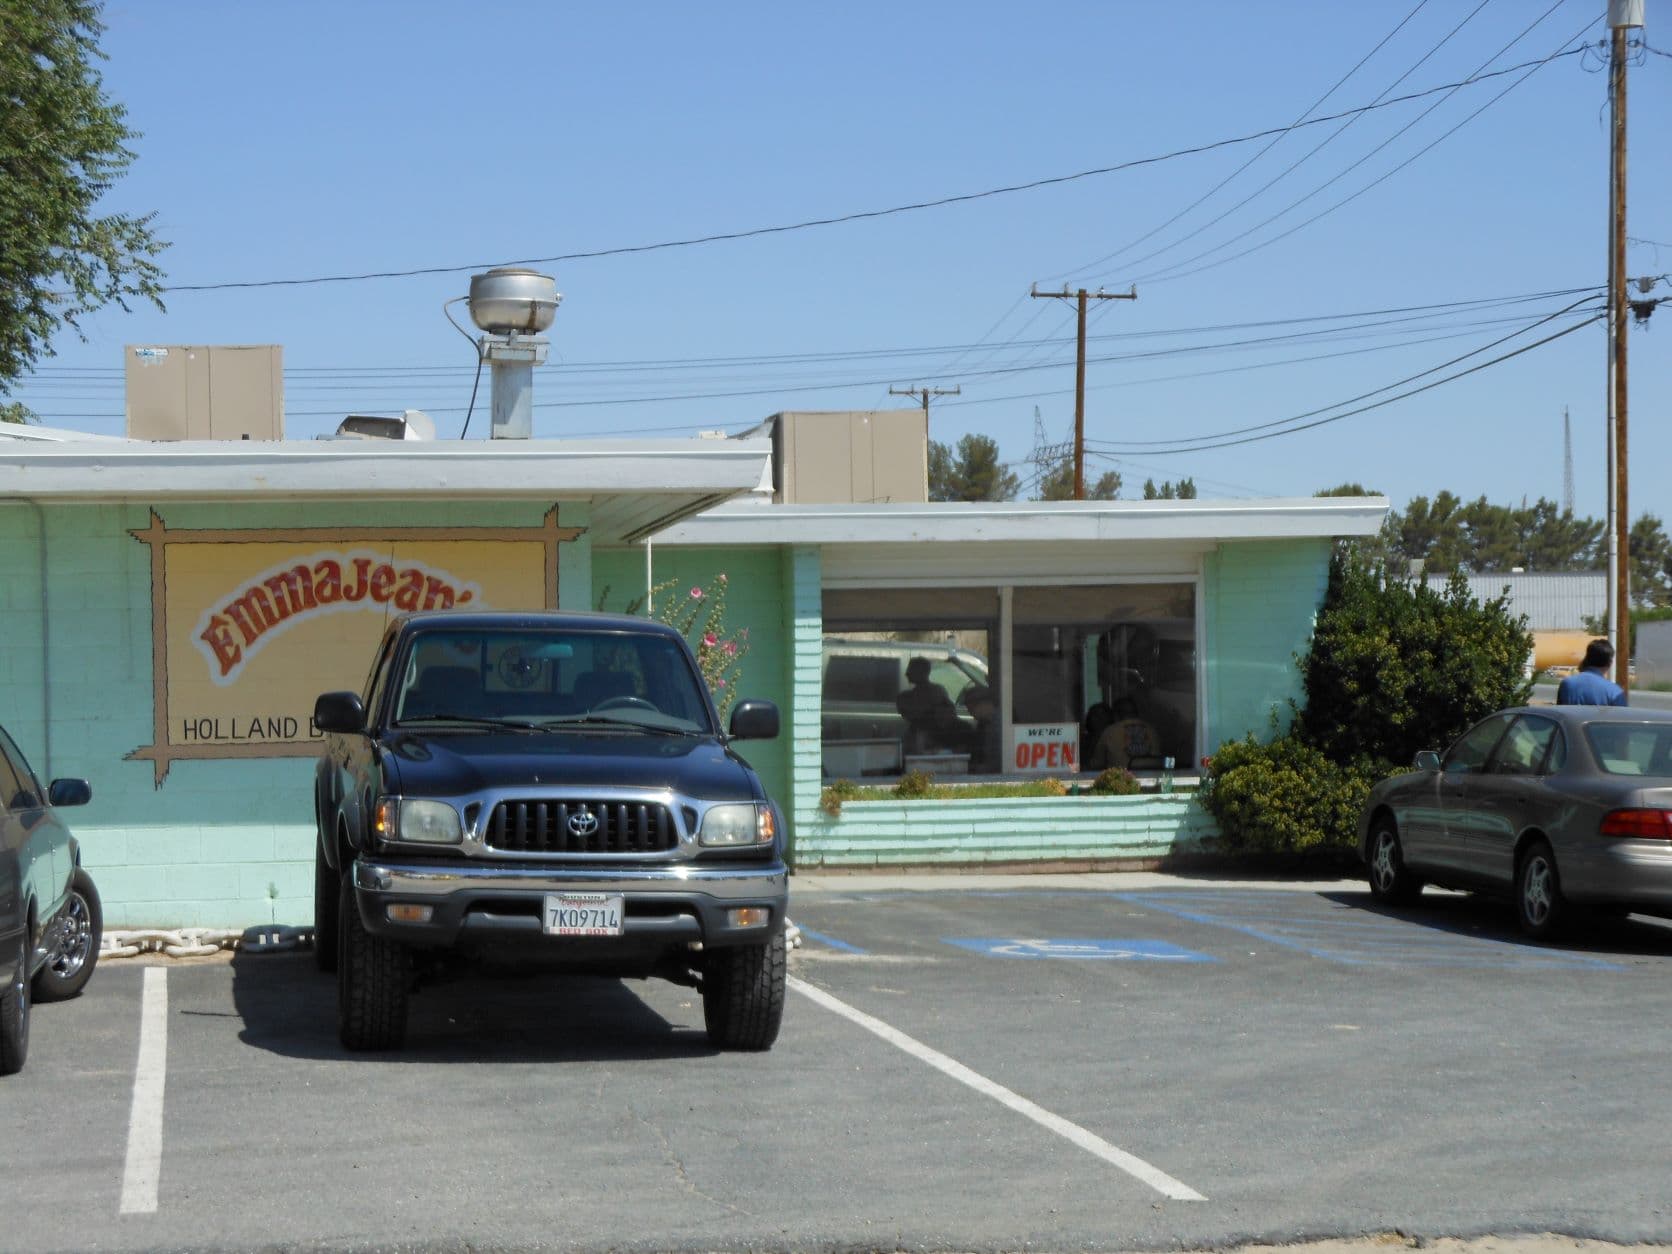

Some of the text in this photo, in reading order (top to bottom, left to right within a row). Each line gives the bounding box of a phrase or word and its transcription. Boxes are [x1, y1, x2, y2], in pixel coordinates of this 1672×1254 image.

[184, 717, 298, 740] HOLLAND
[1027, 728, 1064, 736] WE'RE
[1016, 743, 1076, 768] OPEN
[549, 909, 618, 928] 7K09714
